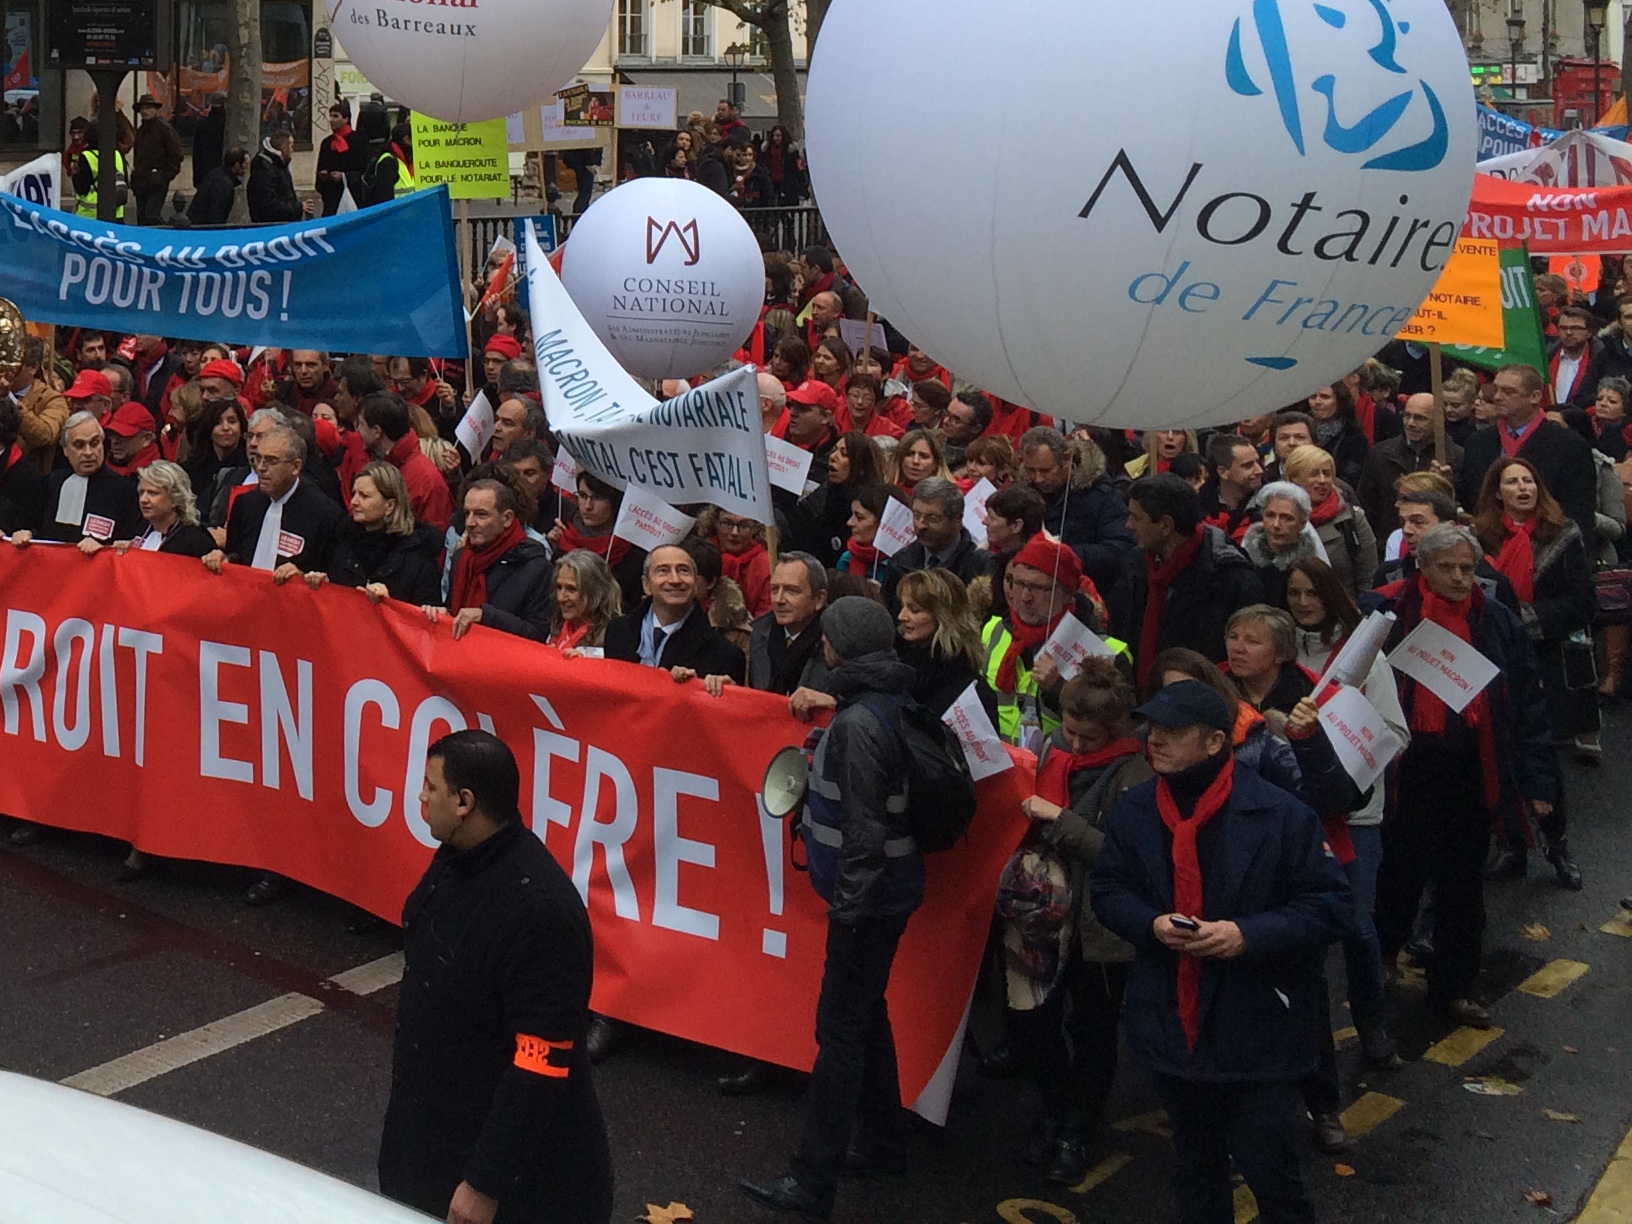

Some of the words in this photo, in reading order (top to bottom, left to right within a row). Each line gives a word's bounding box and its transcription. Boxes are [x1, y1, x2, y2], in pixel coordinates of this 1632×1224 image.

[350, 8, 370, 26] des
[375, 8, 477, 37] Barreaux
[417, 123, 428, 133] LA
[433, 122, 468, 133] BANQUE
[418, 137, 441, 147] POUR
[419, 160, 430, 169] LA
[434, 158, 498, 169] BANQUEROUTE
[420, 175, 445, 184] POUR
[1526, 191, 1599, 213] NON
[154, 245, 208, 269] AU
[214, 227, 336, 269] DROIT
[1458, 243, 1497, 257] VENTE
[59, 252, 166, 312] POUR
[623, 277, 721, 297] CONSEIL
[1127, 260, 1220, 314] de
[612, 294, 730, 317] NATIONAL
[648, 389, 751, 433] NOTARIALE
[628, 446, 685, 489] C'EST
[1335, 719, 1361, 748] PROJET
[199, 639, 315, 802] EN
[342, 677, 722, 943] COÈRE
